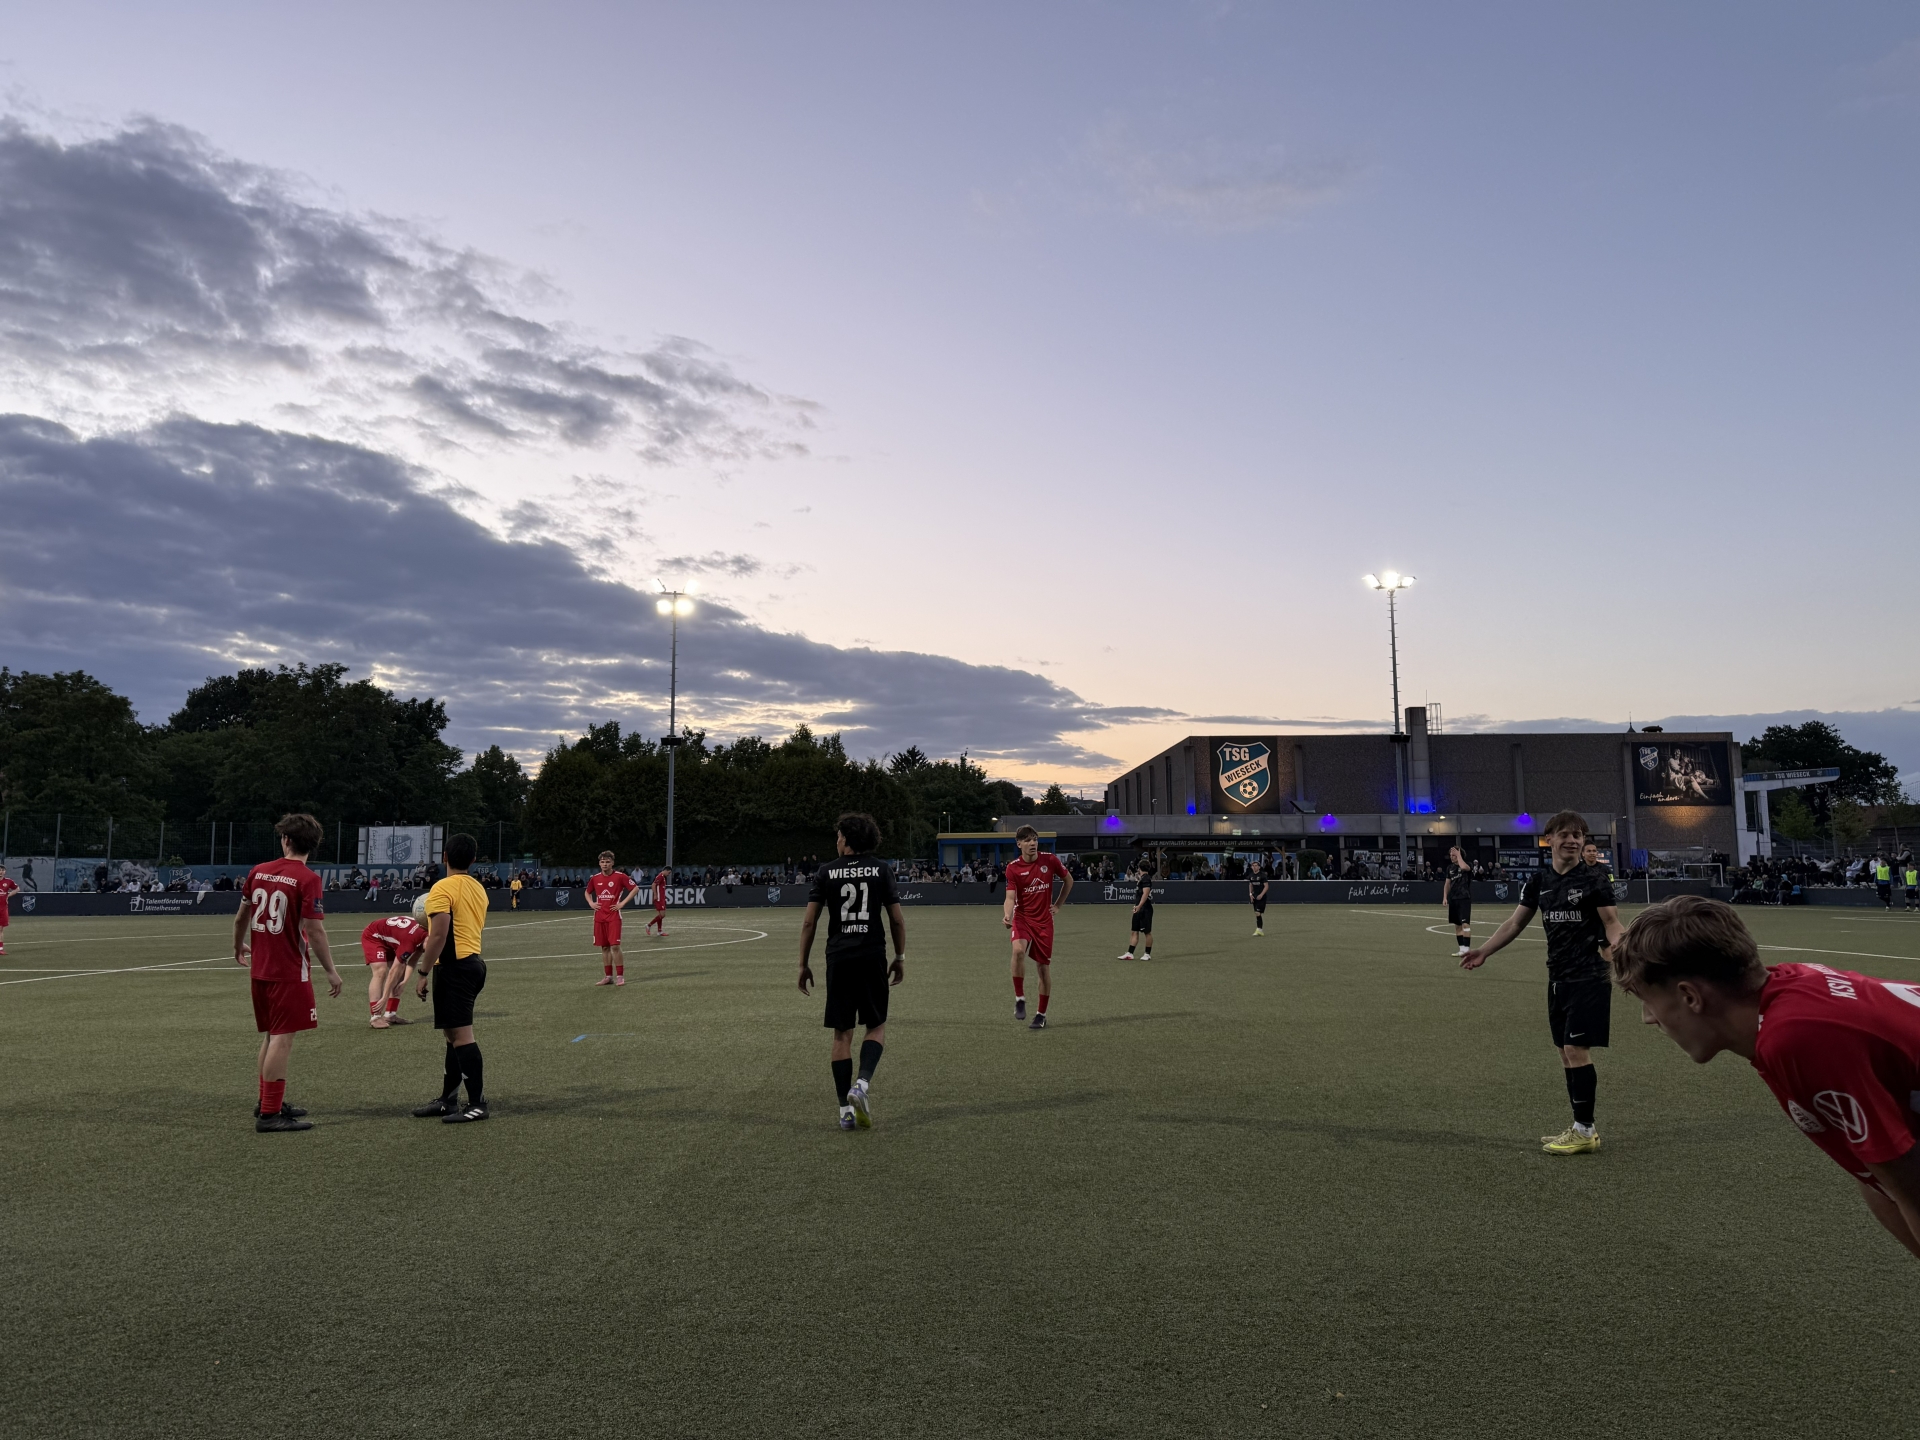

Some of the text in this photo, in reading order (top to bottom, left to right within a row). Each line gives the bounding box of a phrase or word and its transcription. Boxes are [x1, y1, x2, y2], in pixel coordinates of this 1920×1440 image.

[1223, 747, 1250, 762] TSG
[1225, 760, 1262, 783] WIESECK
[1786, 771, 1811, 779] WIESECK
[828, 866, 880, 880] WIESECK
[633, 888, 706, 905] WISECK
[1370, 885, 1390, 895] dich
[1392, 883, 1410, 897] frei
[145, 898, 193, 906] Talentförderung
[841, 882, 869, 922] 21
[251, 887, 289, 935] 29
[1825, 974, 1858, 1000] KSV
